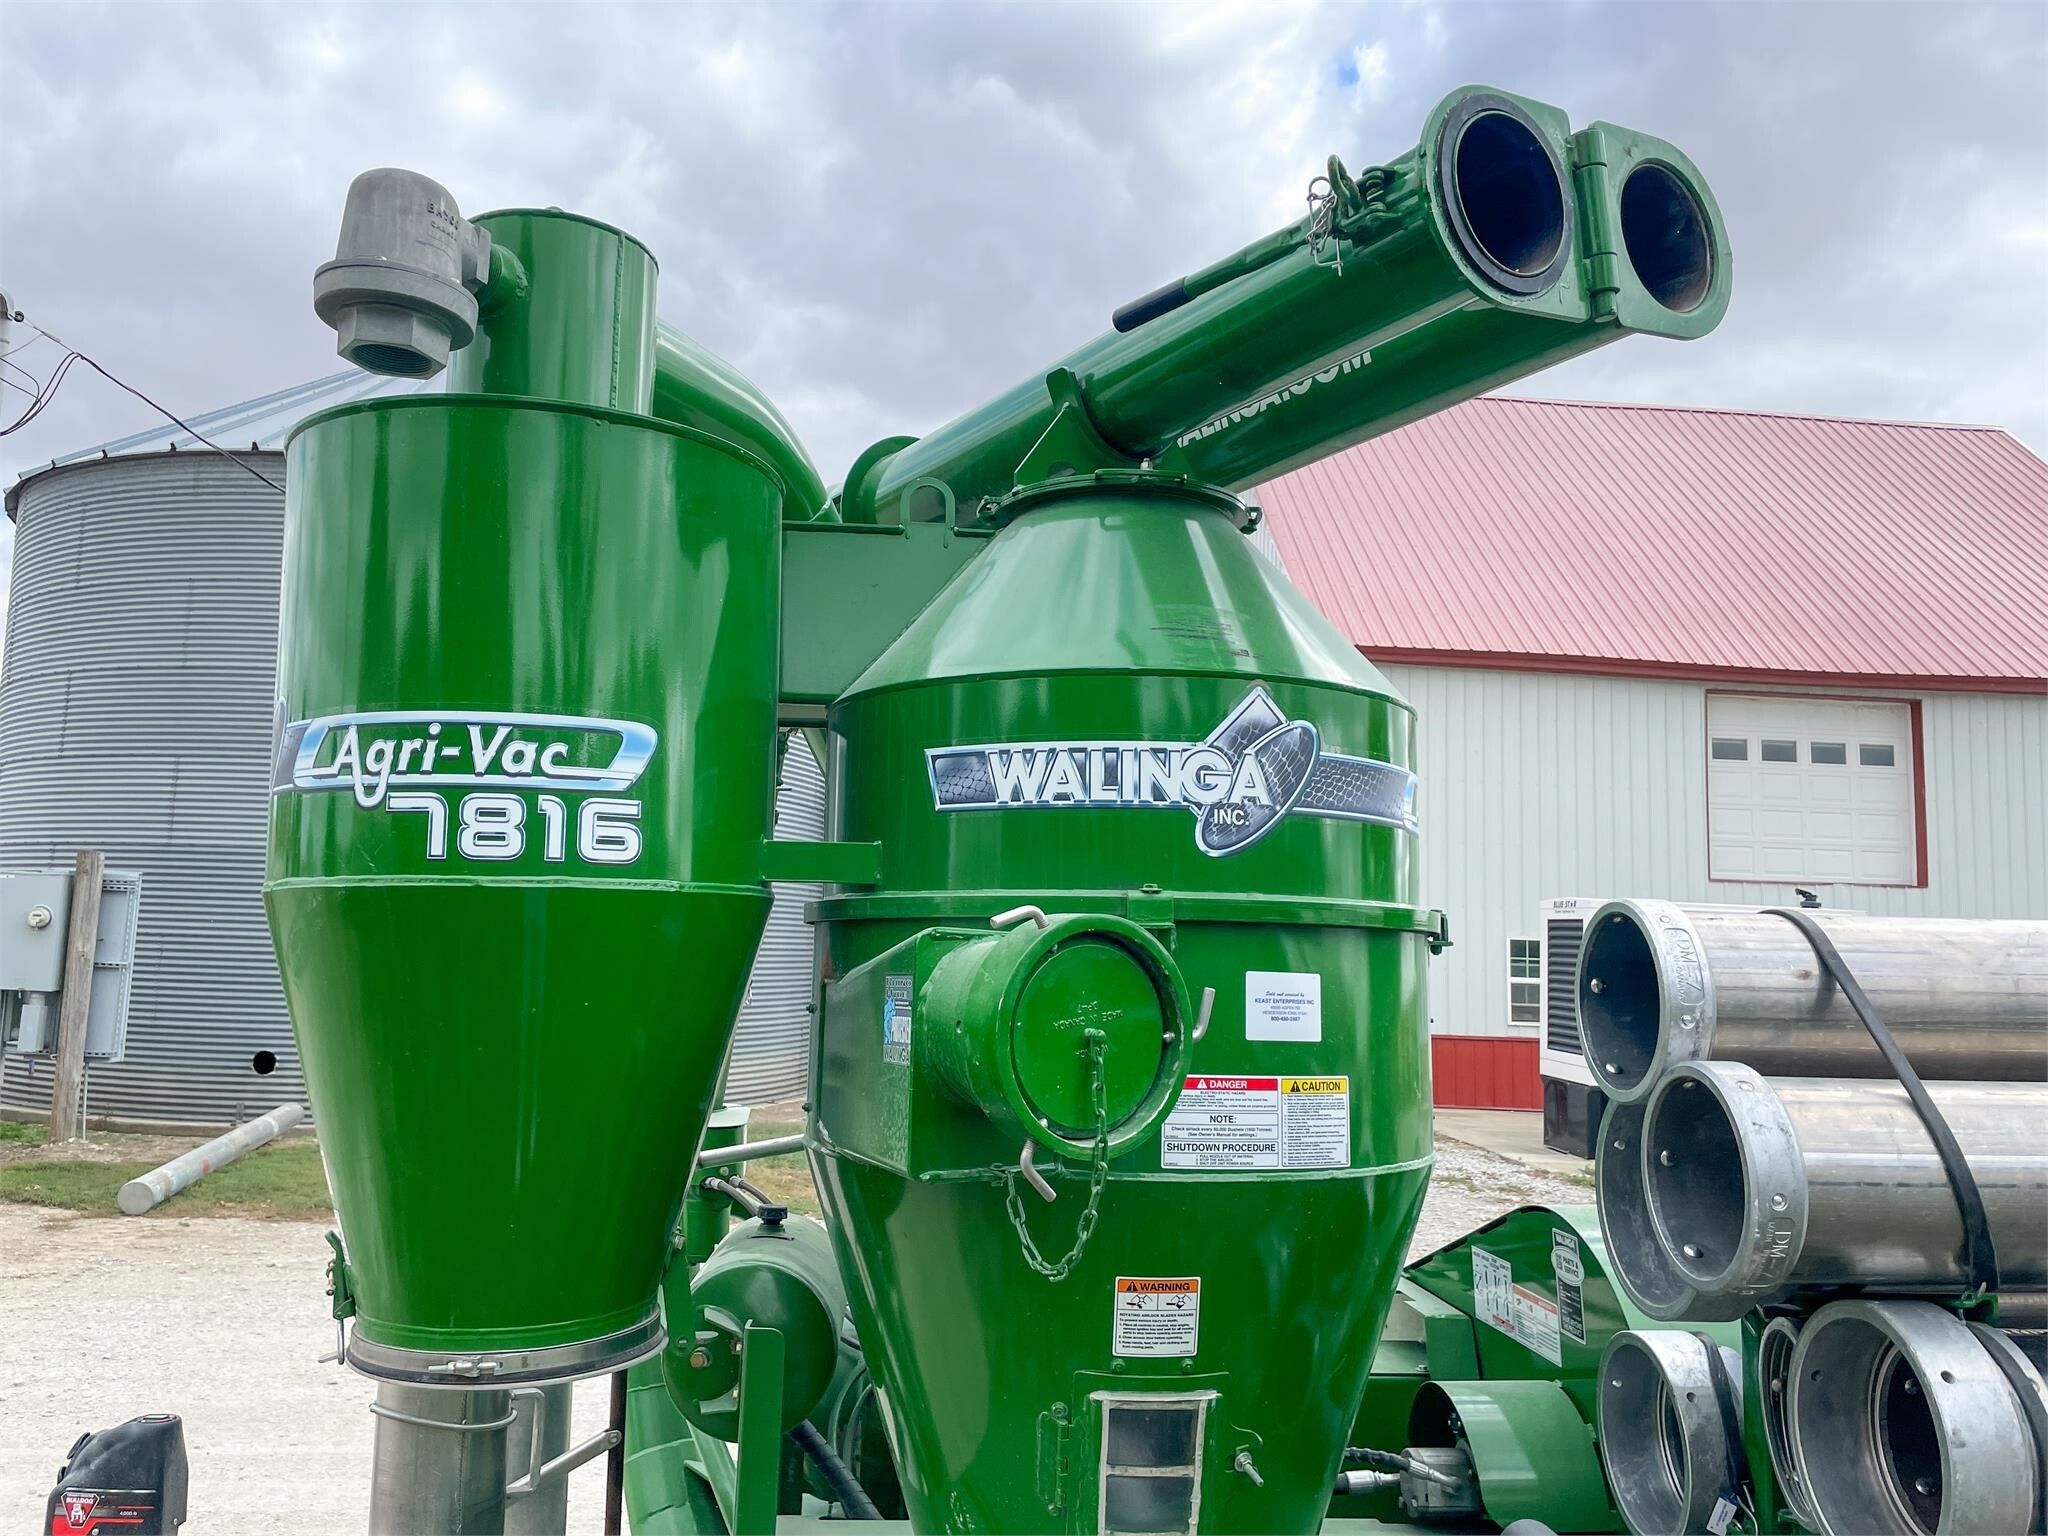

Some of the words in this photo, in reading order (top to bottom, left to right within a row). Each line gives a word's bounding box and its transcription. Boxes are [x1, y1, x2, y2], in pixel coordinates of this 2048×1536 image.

[328, 721, 572, 808] Agri-Vac
[988, 748, 1274, 807] WALINGA
[1212, 808, 1250, 828] INC.
[385, 792, 643, 864] 7816
[1209, 1080, 1248, 1089] DANGER
[1302, 1081, 1341, 1092] CAUTION
[1209, 1115, 1237, 1123] NOTE:
[1166, 1143, 1220, 1152] SHUTDOWN
[1222, 1143, 1276, 1152] PROCEDURE
[1140, 1283, 1190, 1291] WARNING
